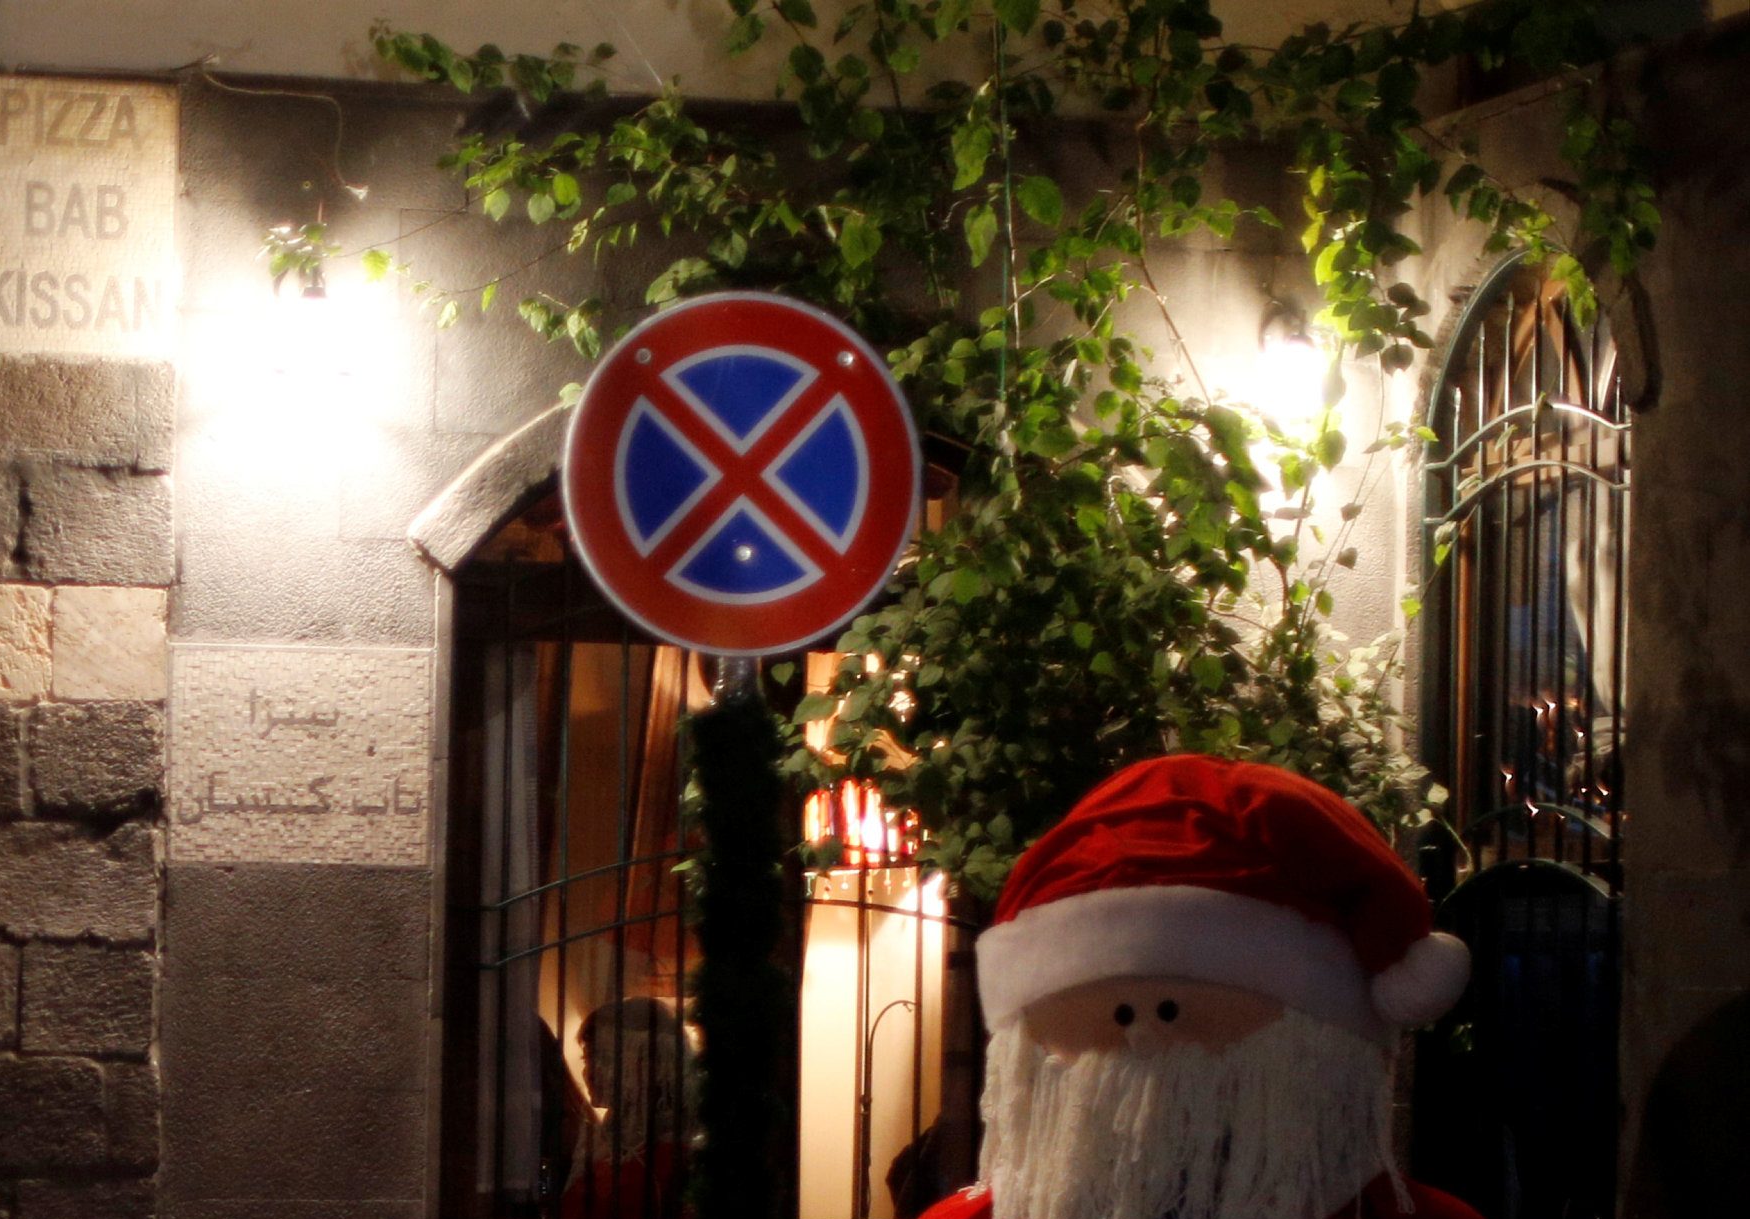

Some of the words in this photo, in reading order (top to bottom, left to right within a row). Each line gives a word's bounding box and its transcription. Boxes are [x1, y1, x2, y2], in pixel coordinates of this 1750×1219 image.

[0, 88, 140, 149] PIZZA
[25, 181, 128, 240] BAB
[250, 688, 340, 740] بيتزا
[352, 774, 421, 827] باب
